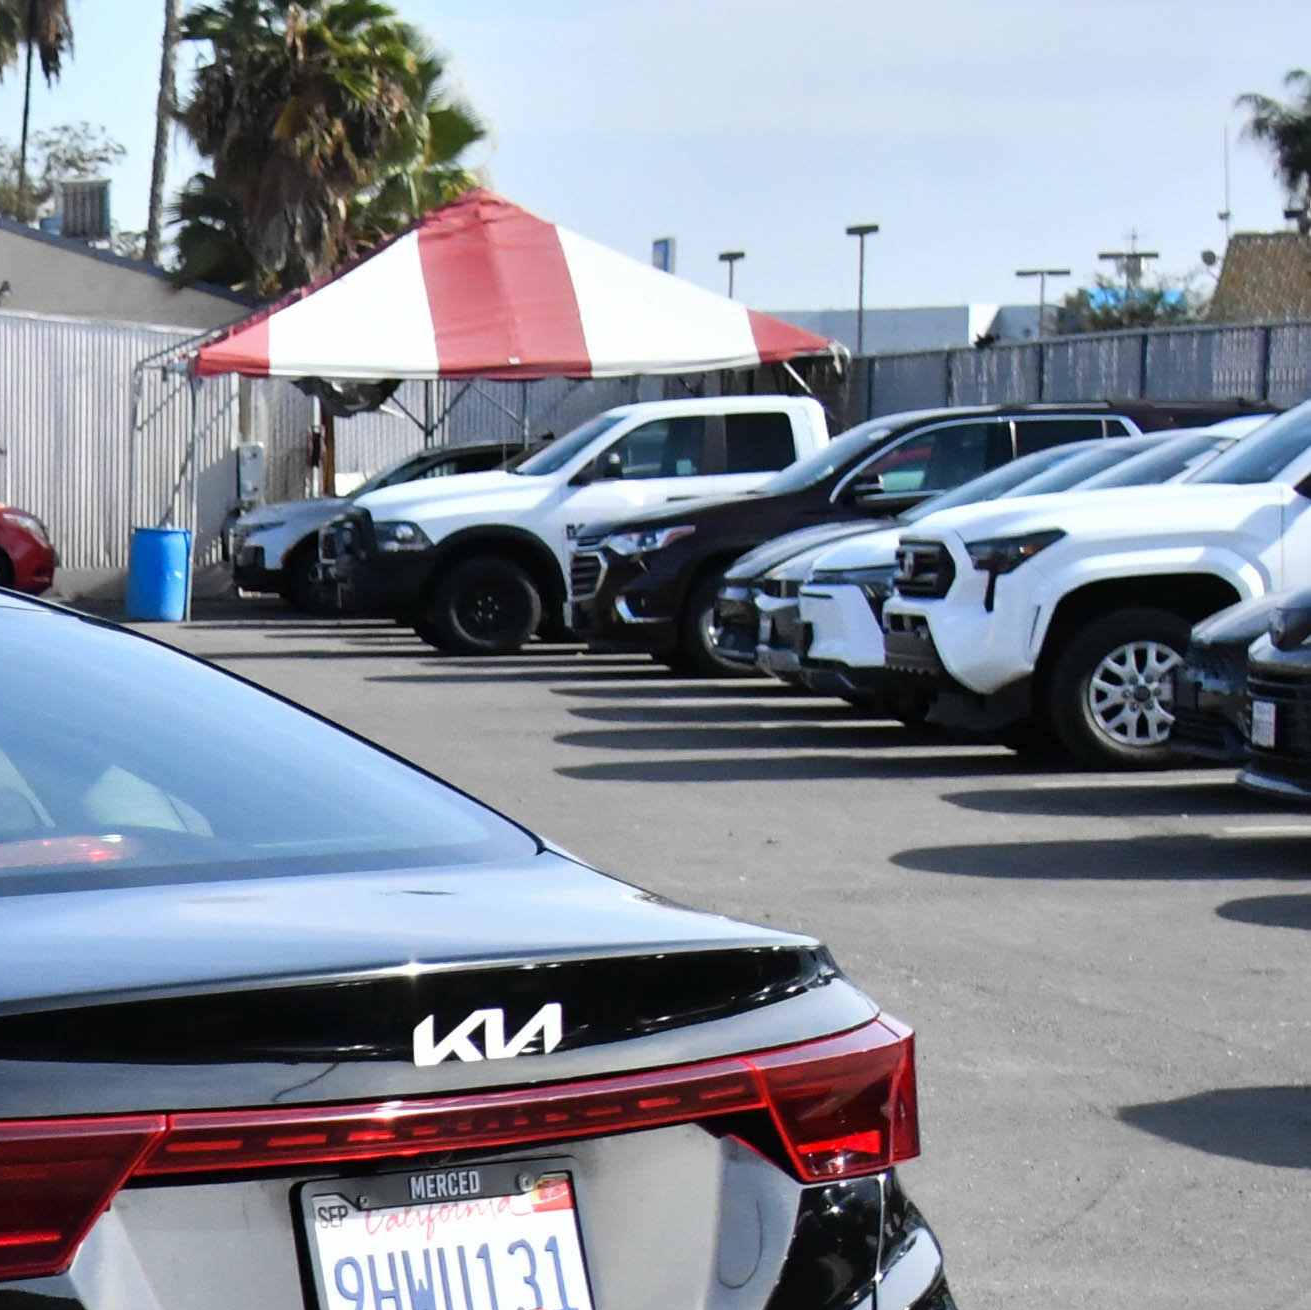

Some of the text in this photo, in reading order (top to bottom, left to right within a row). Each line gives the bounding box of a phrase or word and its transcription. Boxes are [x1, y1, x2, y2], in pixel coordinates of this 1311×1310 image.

[413, 1002, 563, 1067] KIA
[409, 1170, 481, 1200] MERCED
[317, 1203, 349, 1229] SEP
